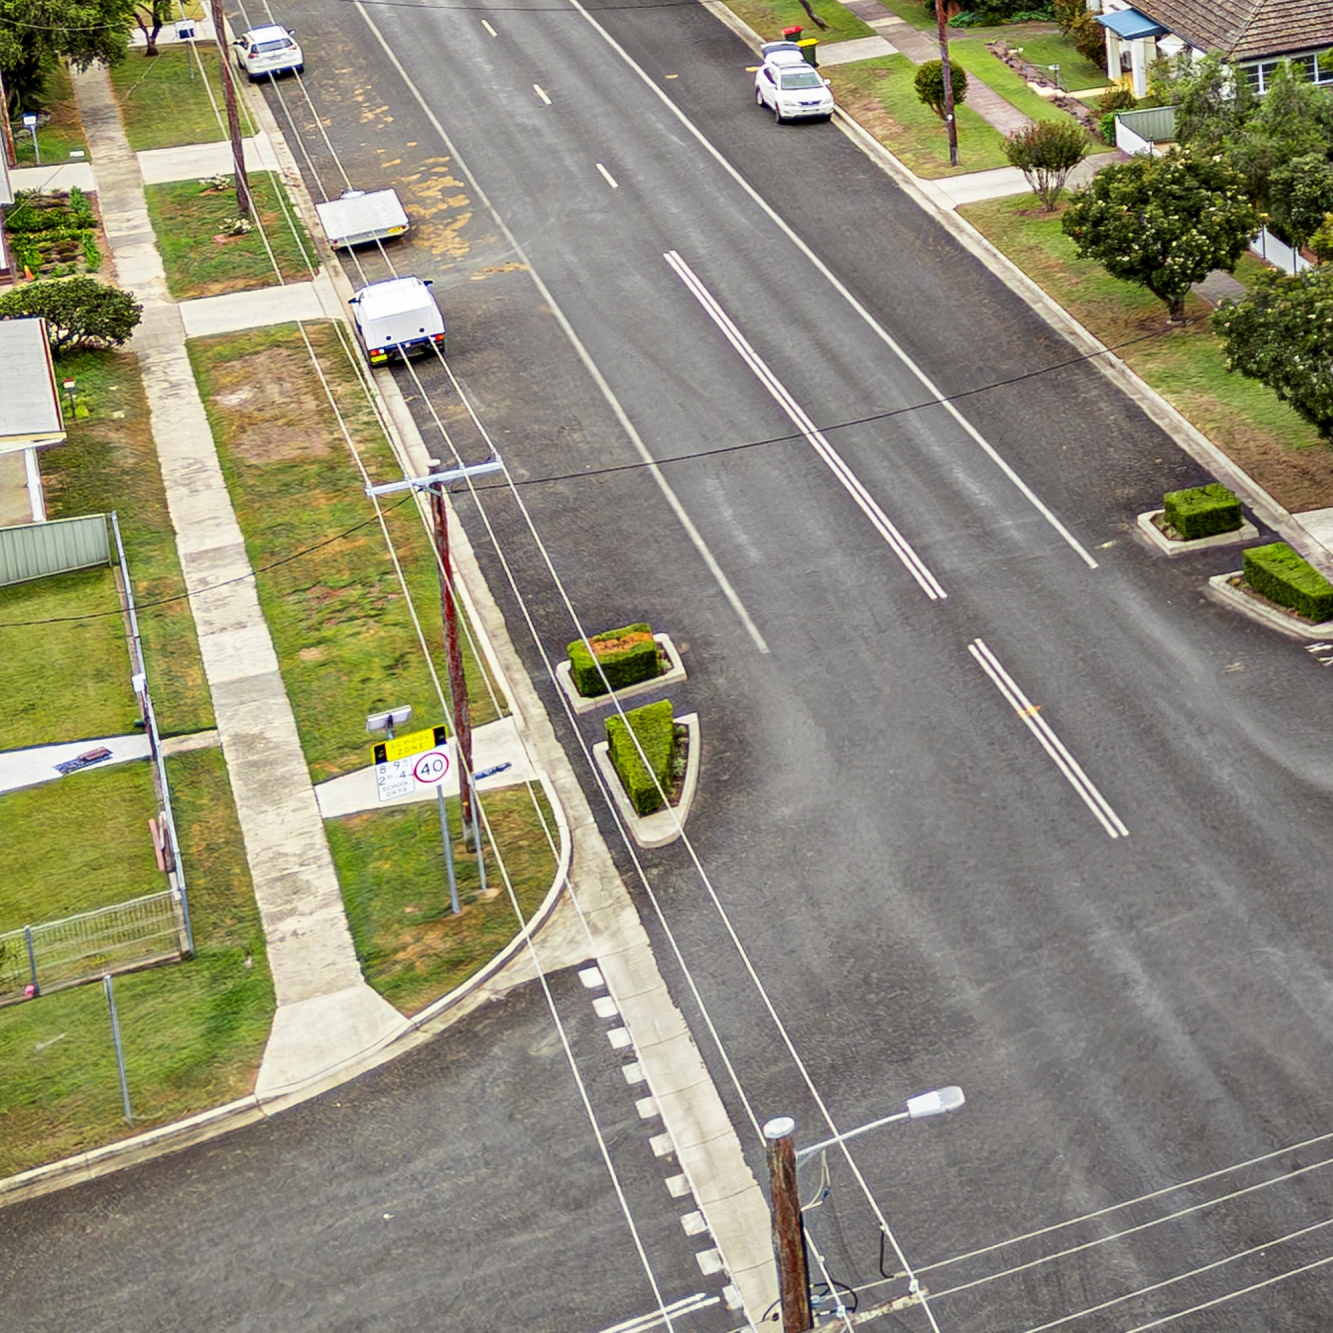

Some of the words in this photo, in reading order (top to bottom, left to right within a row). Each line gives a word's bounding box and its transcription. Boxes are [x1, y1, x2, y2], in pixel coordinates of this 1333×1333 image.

[390, 734, 430, 749] SCHOOL
[398, 742, 425, 756] ZONE
[421, 759, 443, 775] 40
